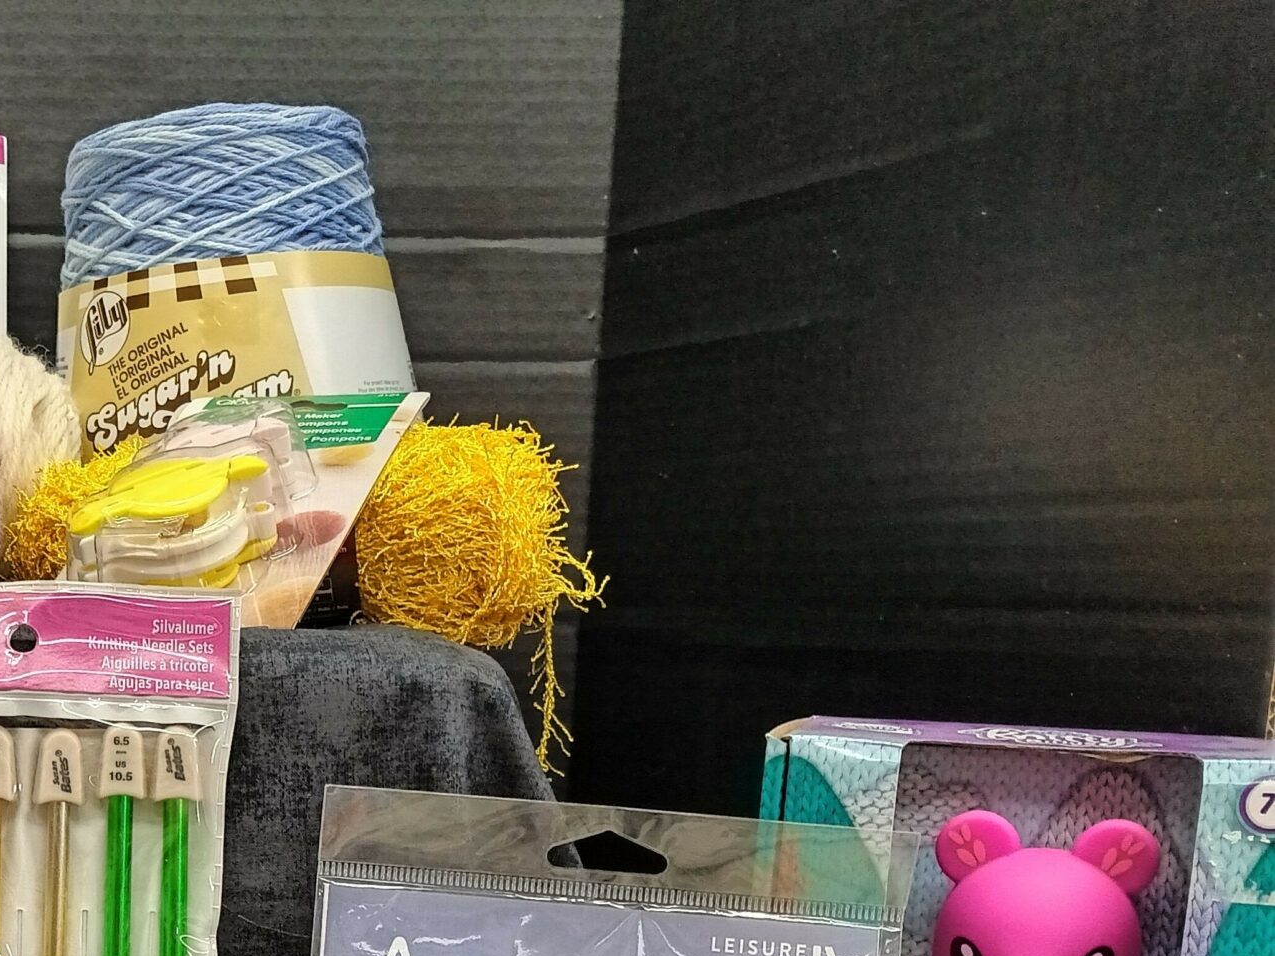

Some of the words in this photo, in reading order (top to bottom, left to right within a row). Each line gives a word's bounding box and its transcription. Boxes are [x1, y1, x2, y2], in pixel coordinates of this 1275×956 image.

[107, 356, 126, 377] THE
[128, 322, 188, 362] ORIGINAL
[112, 344, 175, 389] L'ORIGINAL
[117, 386, 129, 400] EL
[130, 352, 189, 390] ORIGINAL
[152, 619, 214, 635] Silvalume
[88, 636, 138, 654] Knitting
[142, 640, 185, 653] Needle
[188, 640, 214, 654] Sets
[102, 656, 156, 672] Aiguilles
[170, 660, 214, 673] tricoter
[109, 676, 151, 692] Agujas
[155, 680, 182, 692] para
[186, 679, 214, 694] tejer
[113, 736, 130, 746] 6.5
[60, 757, 72, 793] Bates
[109, 771, 133, 781] 10.5
